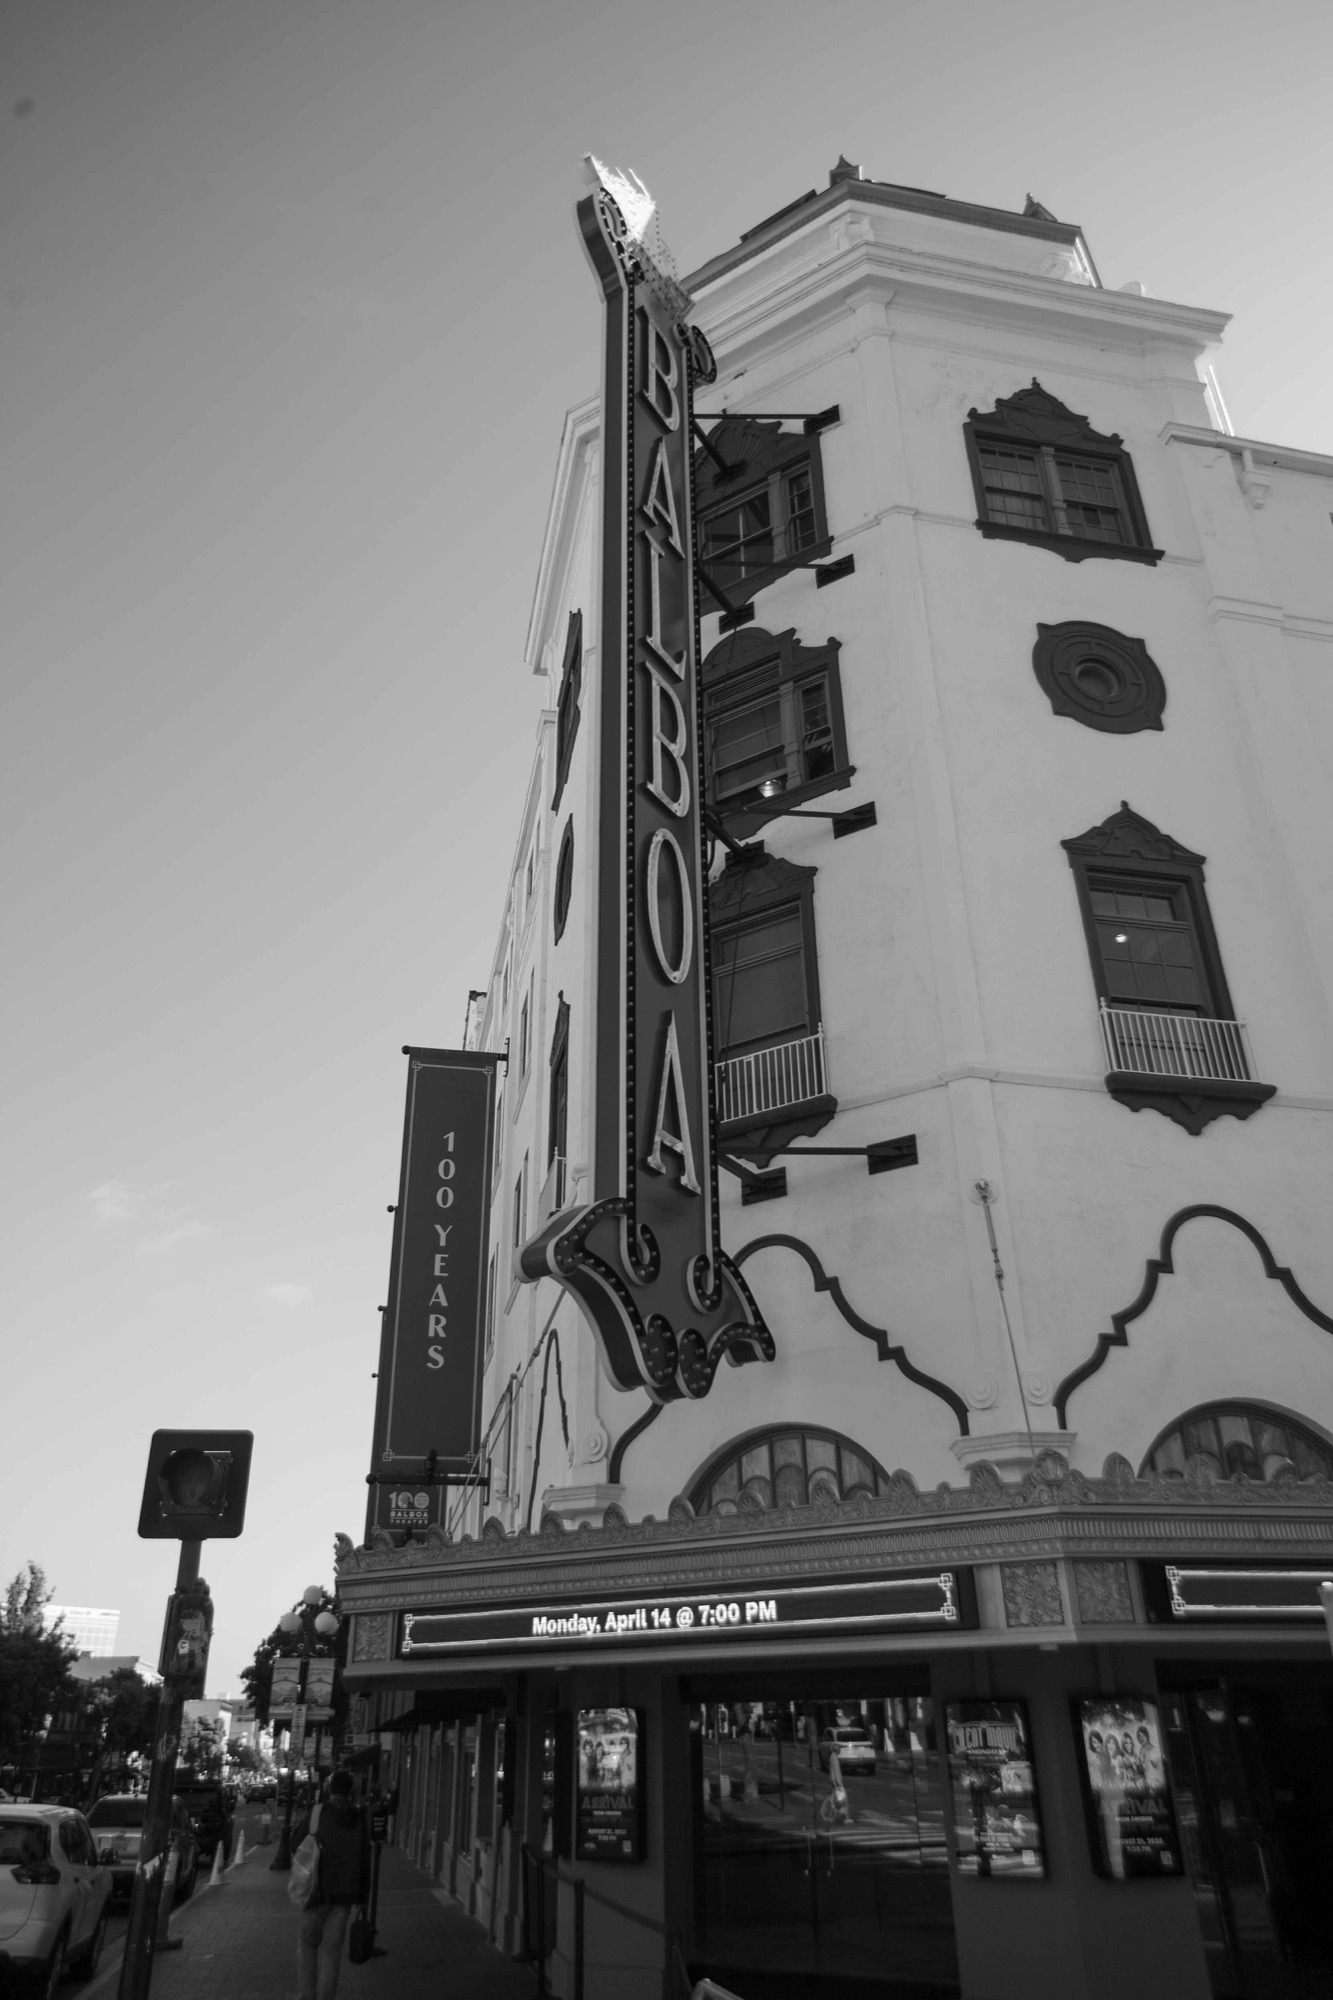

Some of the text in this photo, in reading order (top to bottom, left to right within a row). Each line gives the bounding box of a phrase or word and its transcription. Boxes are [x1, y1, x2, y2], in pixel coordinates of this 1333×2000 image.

[636, 306, 702, 1196] BALBOA
[427, 1132, 455, 1368] 100 YEARS
[532, 1600, 778, 1635] Monday, April 14 @ 7:00 PM
